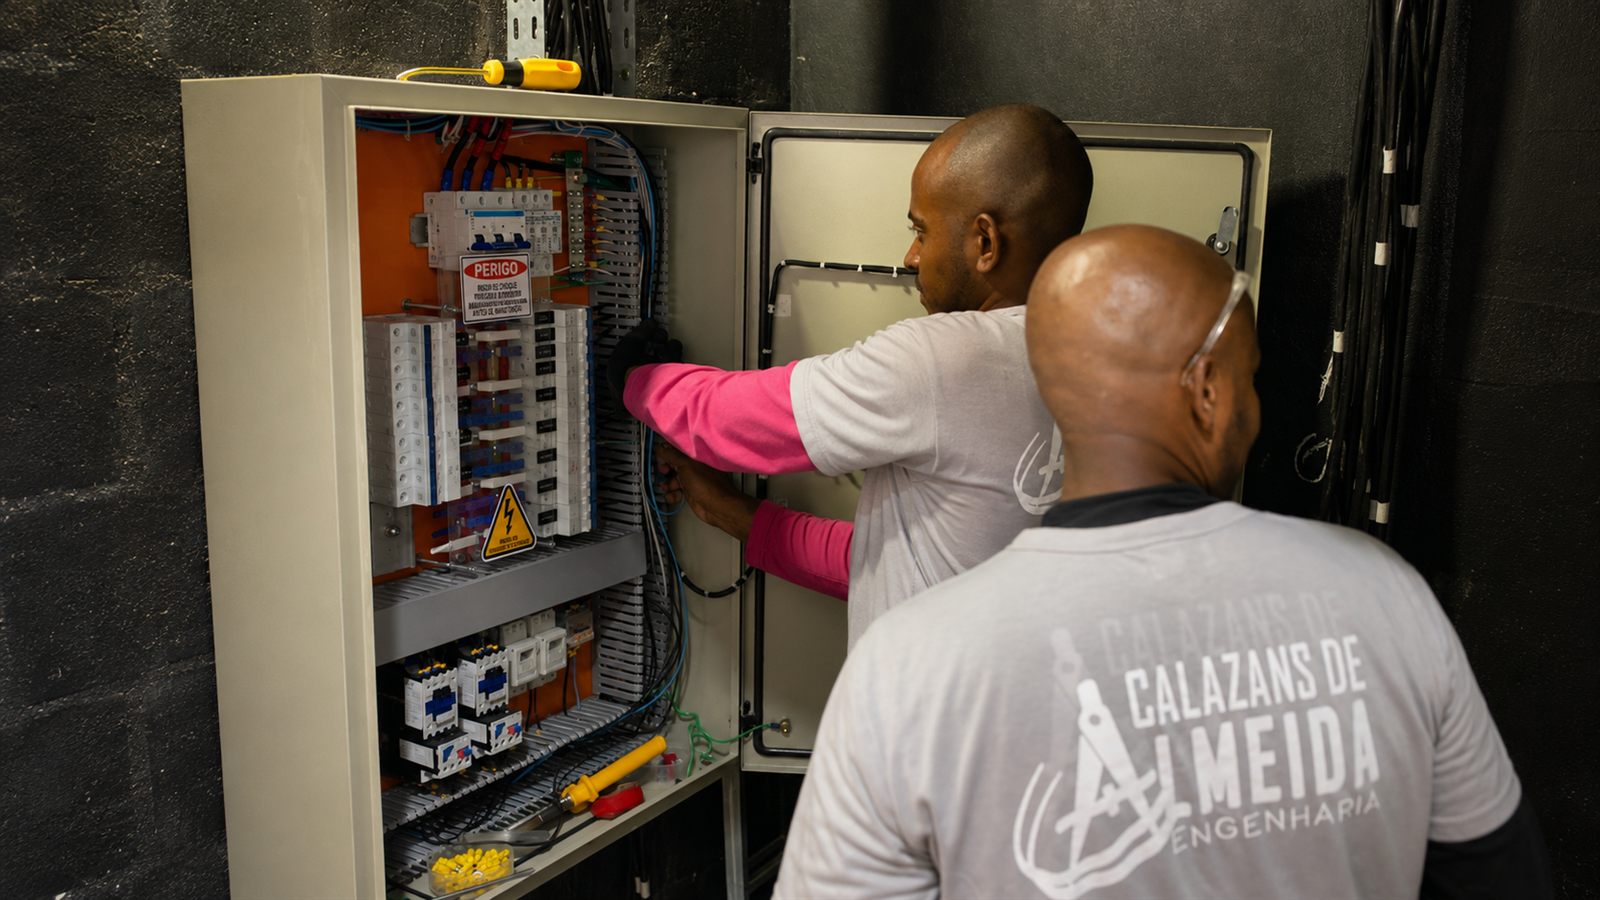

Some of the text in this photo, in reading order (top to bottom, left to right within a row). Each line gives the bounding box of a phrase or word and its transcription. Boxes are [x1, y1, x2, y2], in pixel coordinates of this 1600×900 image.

[474, 262, 518, 277] PERIGO
[1124, 634, 1366, 729] CALAZANS DE
[1056, 679, 1381, 870] ALMEIDA
[1171, 790, 1382, 855] ENGENHARIA
